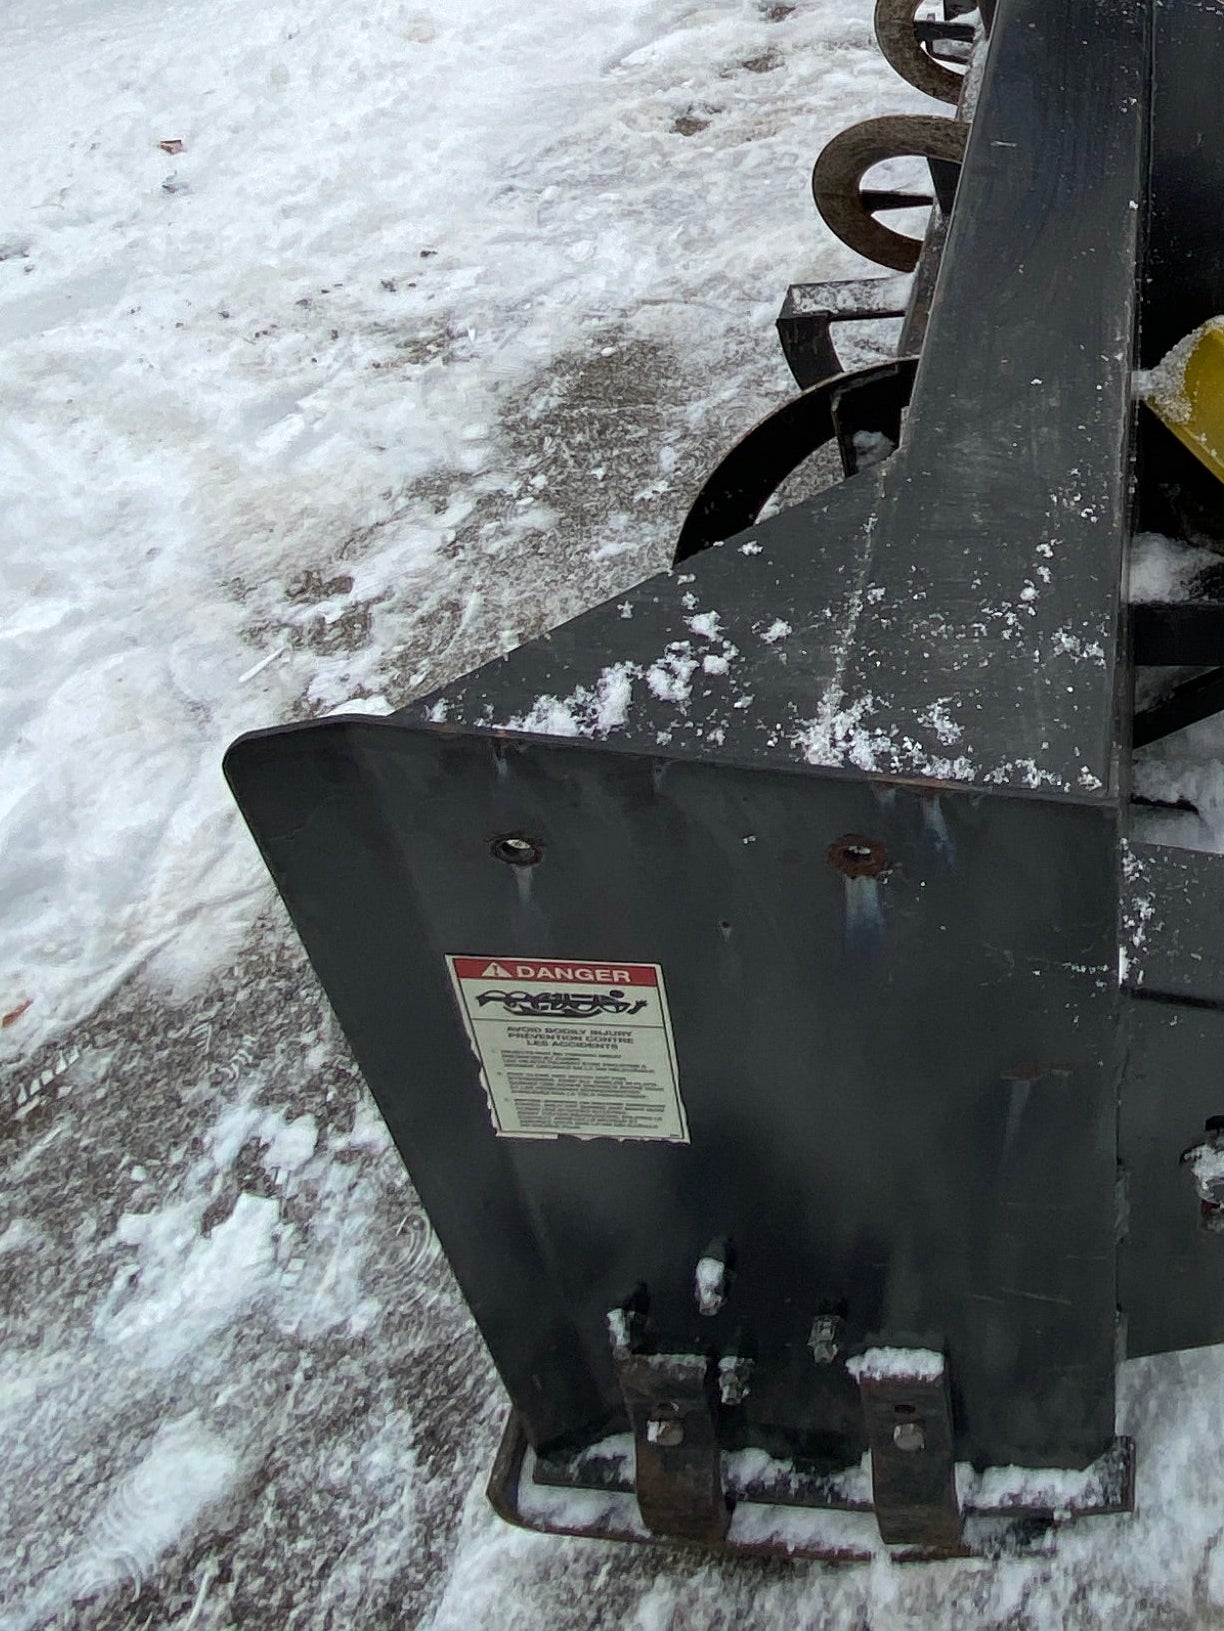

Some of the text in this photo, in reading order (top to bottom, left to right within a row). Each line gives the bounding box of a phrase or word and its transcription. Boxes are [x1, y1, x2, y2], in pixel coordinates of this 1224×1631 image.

[516, 966, 631, 983] DANGER
[544, 1027, 586, 1035] BODILY
[589, 1029, 633, 1037] INJURY
[551, 1040, 619, 1050] ACCIDENTS
[585, 1036, 634, 1044] CONTRE
